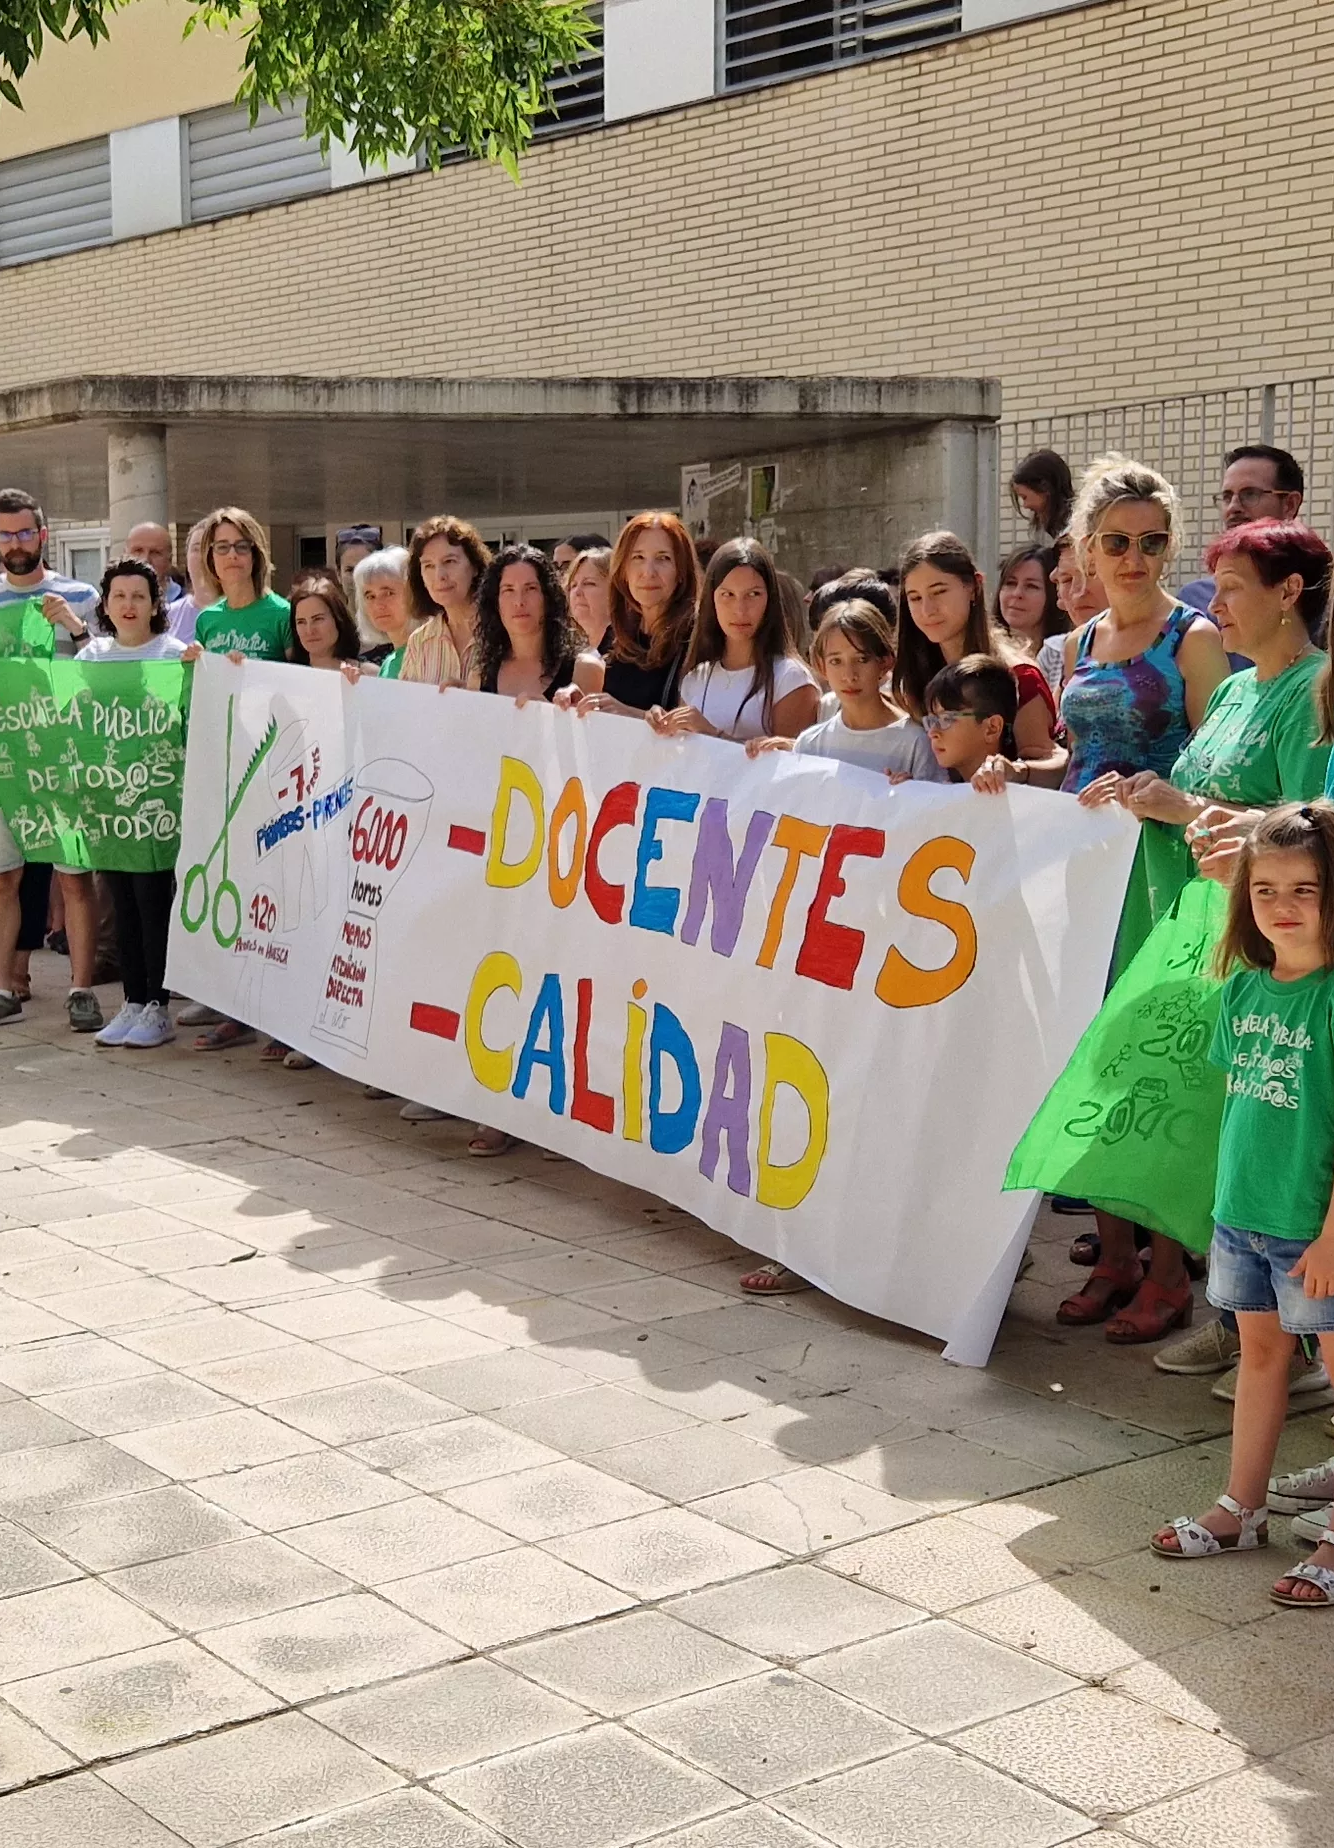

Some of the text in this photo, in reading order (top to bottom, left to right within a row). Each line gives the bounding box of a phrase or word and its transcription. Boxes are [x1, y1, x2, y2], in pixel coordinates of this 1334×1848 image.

[27, 761, 176, 794] DE TOD@S
[96, 811, 182, 842] TOD@
[351, 864, 383, 907] horas
[248, 893, 277, 933] -120
